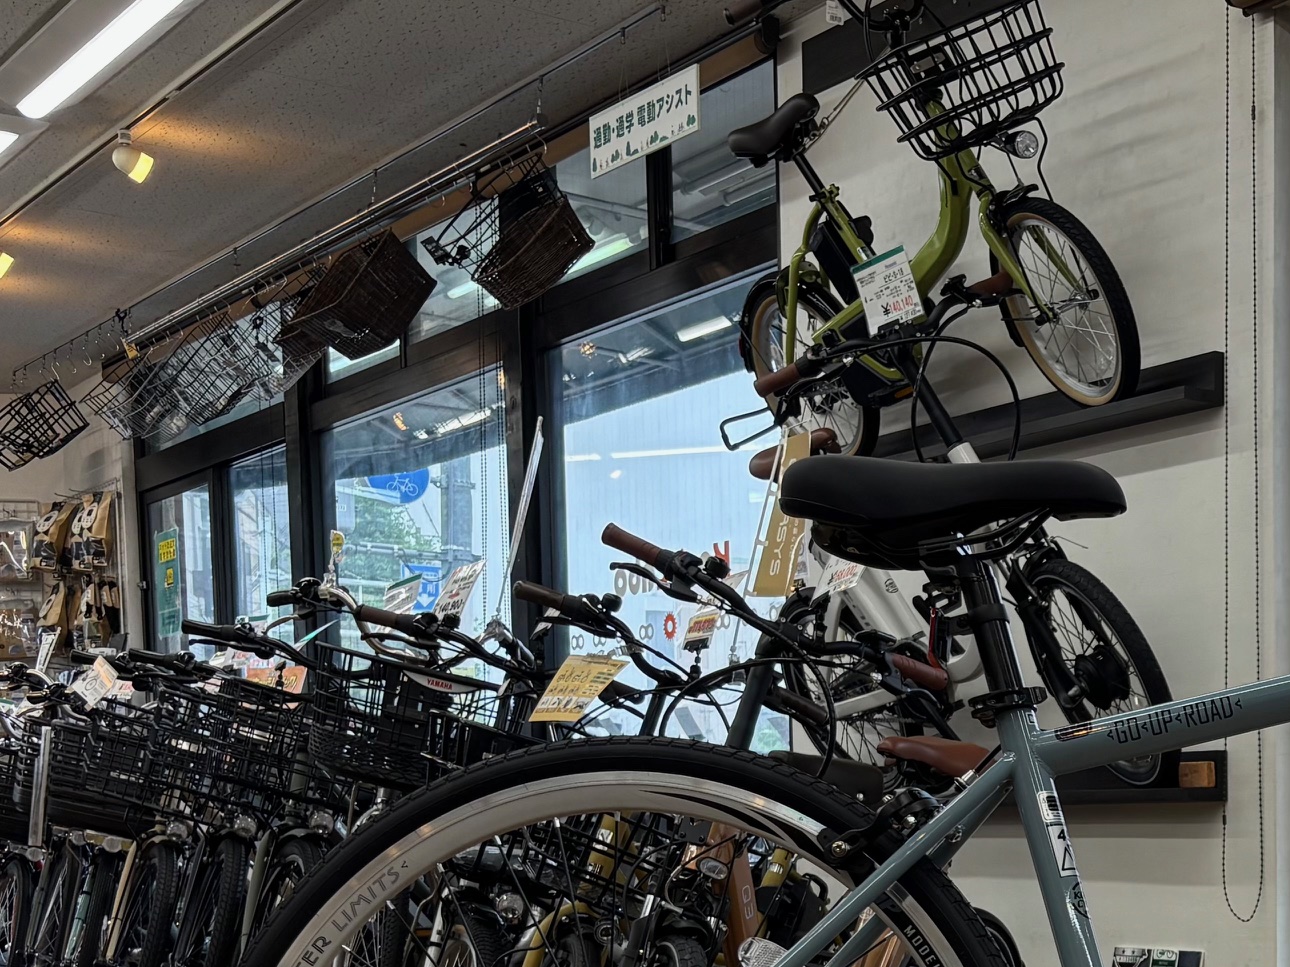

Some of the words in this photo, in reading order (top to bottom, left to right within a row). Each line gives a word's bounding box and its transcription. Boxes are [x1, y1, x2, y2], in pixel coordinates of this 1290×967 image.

[636, 83, 692, 128] 電動アシスト
[427, 678, 453, 691] YAMAHA
[330, 865, 401, 933] LIMITS
